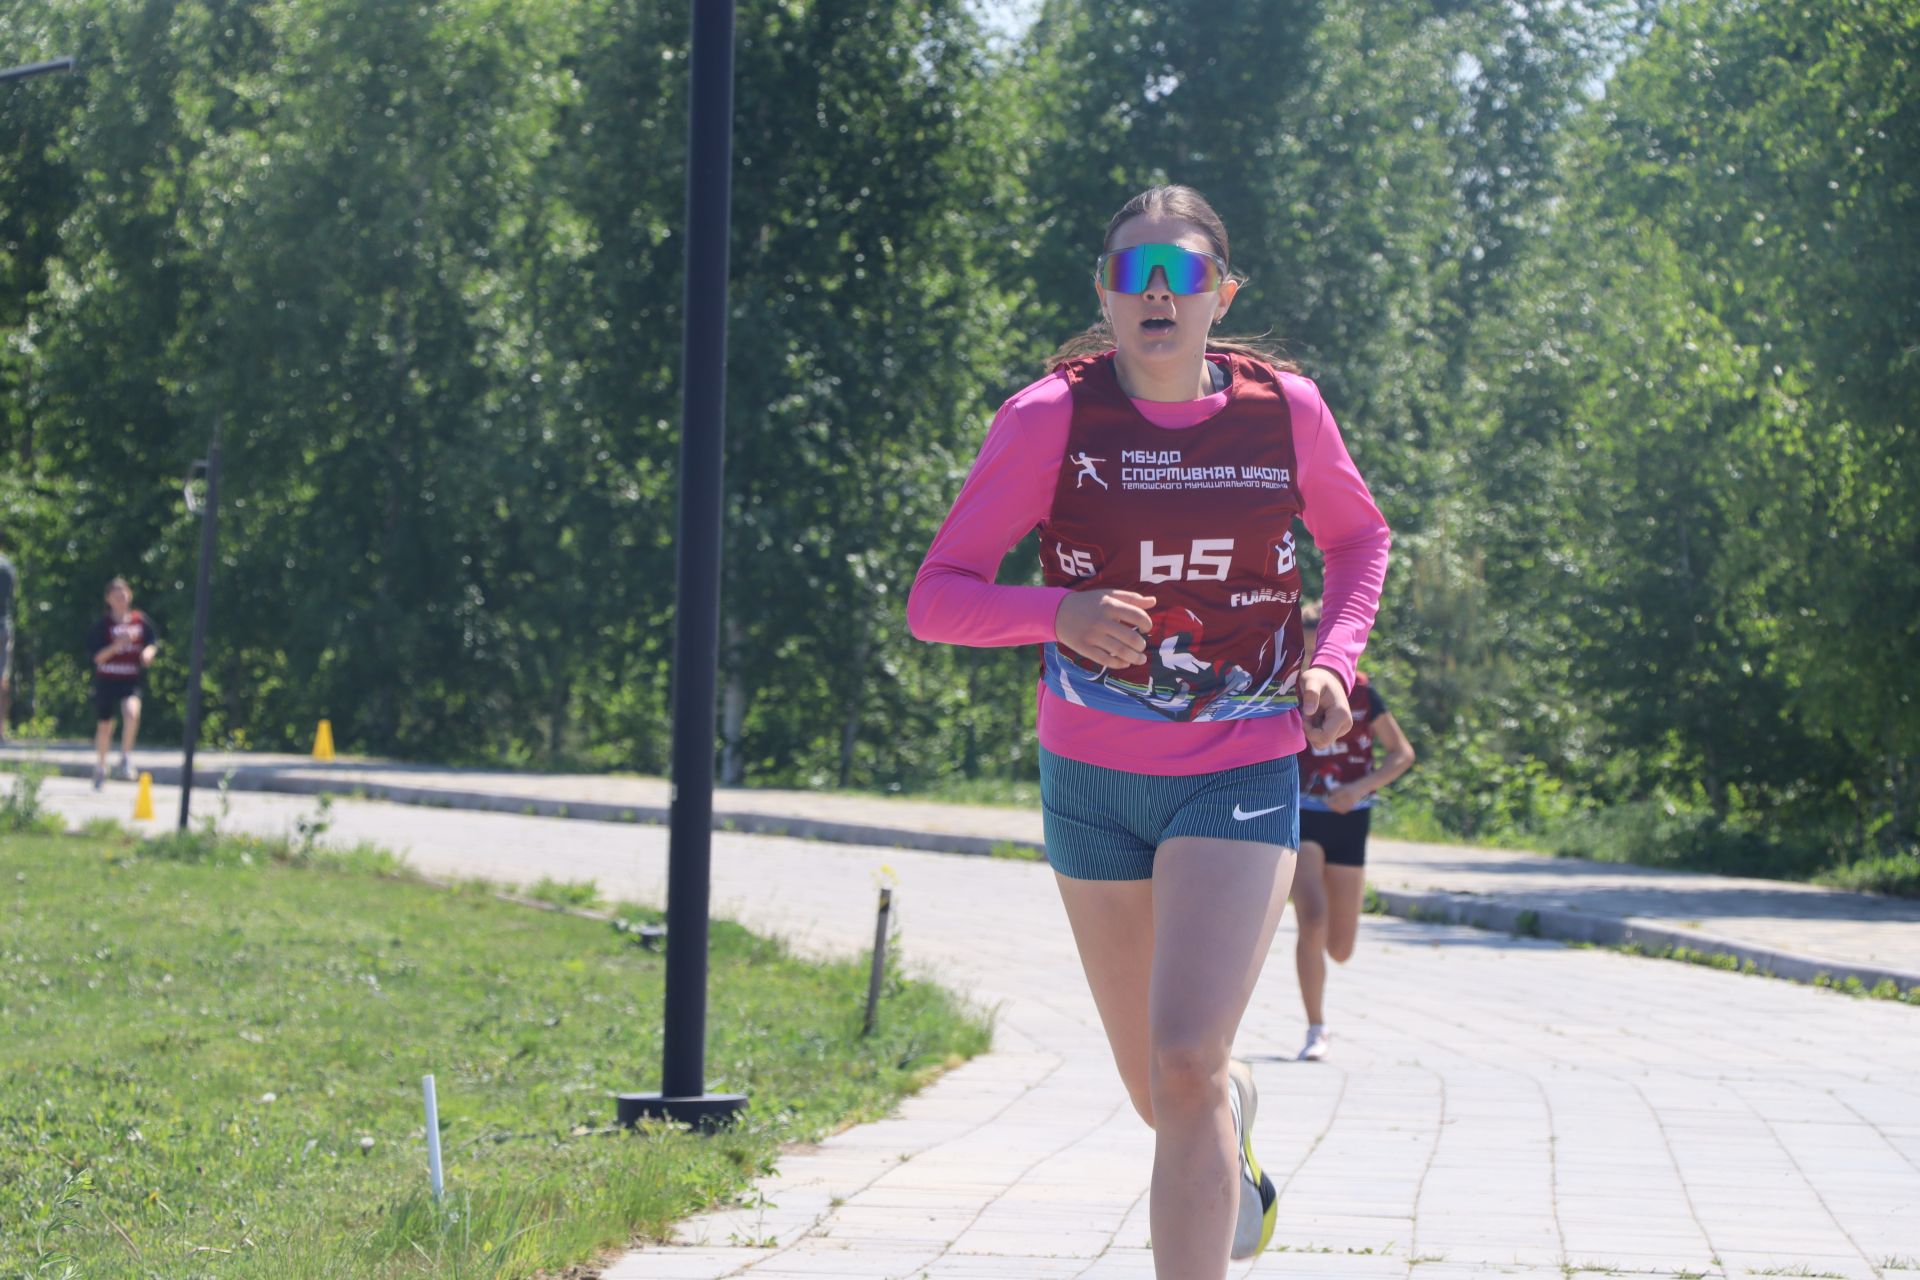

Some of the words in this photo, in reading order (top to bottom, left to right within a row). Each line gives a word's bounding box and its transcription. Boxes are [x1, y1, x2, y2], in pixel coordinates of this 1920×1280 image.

[1121, 450, 1182, 465] МБУДО
[1121, 466, 1237, 481] СПОРТИВНАЯ
[1240, 466, 1291, 482] ШКОЛА
[1055, 541, 1097, 578] 65
[1140, 538, 1235, 584] 65
